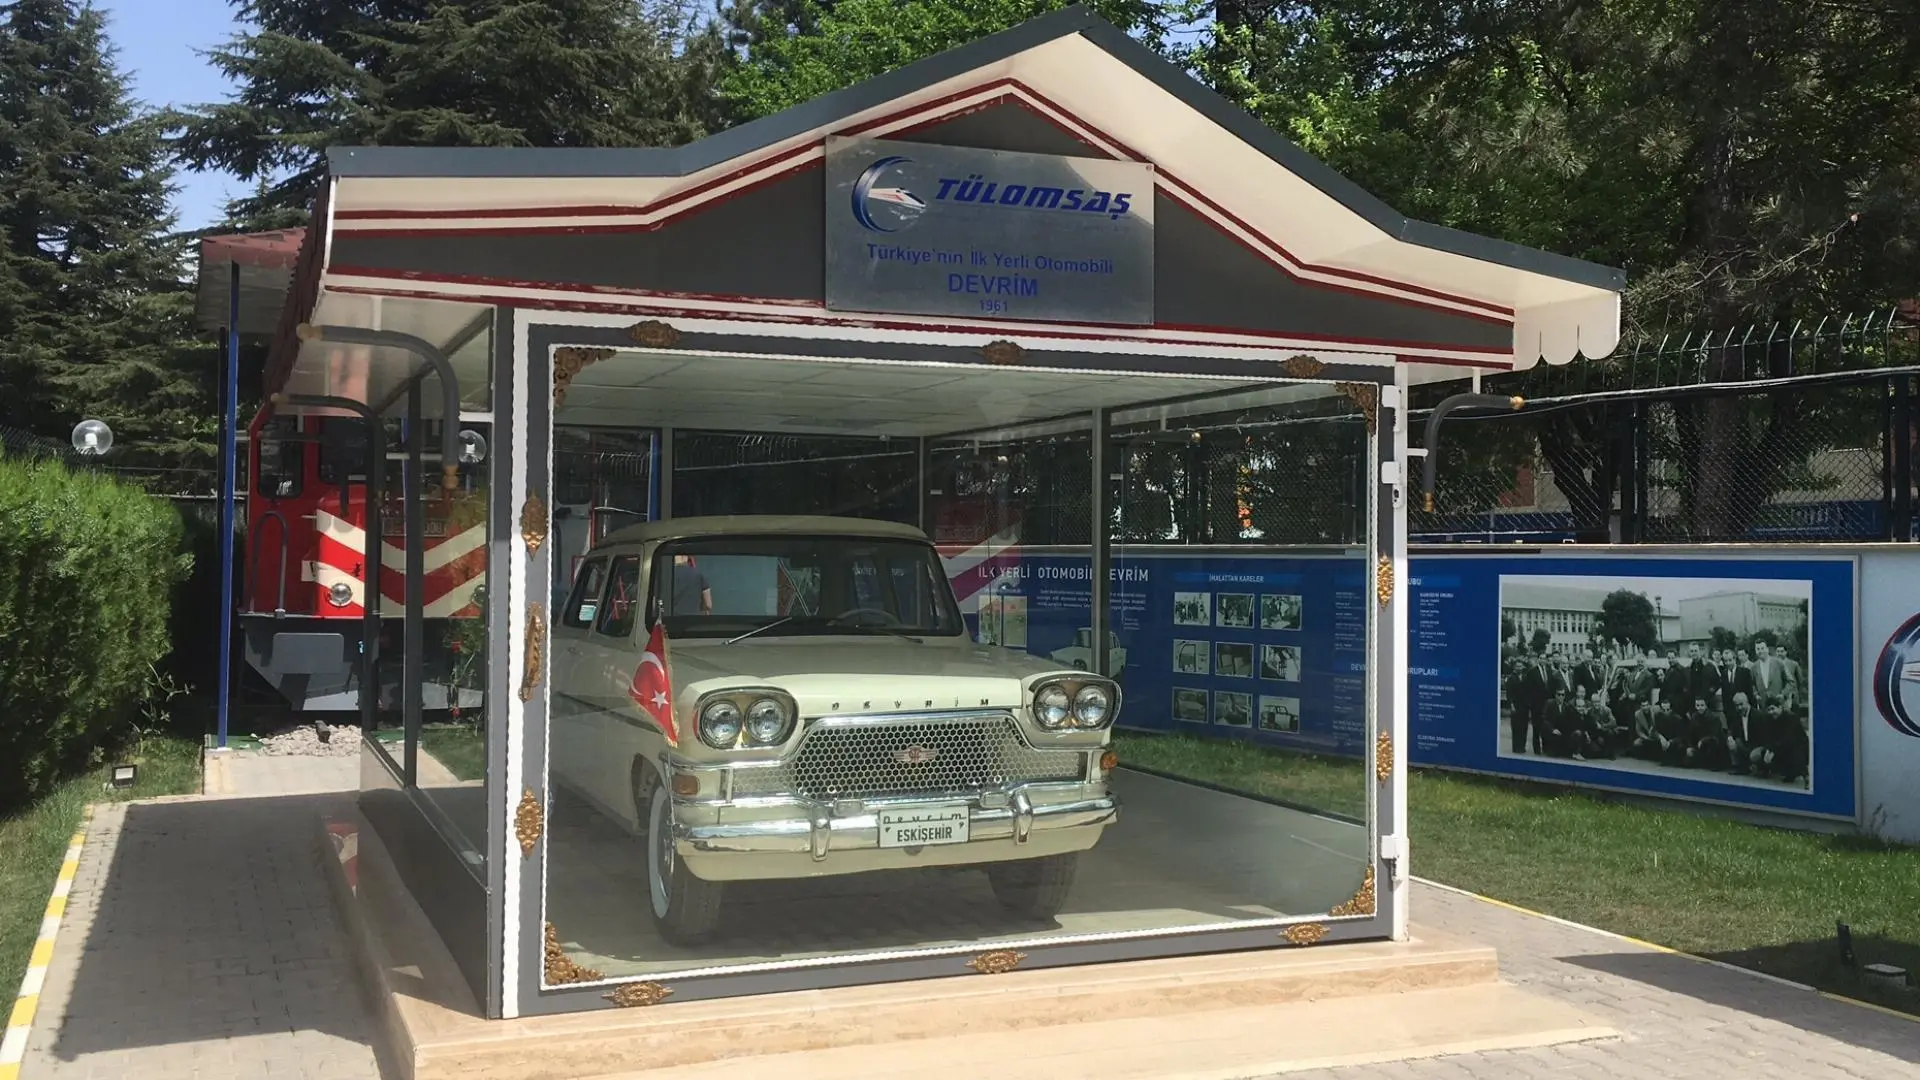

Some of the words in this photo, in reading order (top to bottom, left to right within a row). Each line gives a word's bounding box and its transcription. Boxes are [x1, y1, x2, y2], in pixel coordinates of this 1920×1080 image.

[935, 174, 1132, 220] TÜLOMSAŞ
[1035, 255, 1113, 273] Otomobili
[948, 272, 1039, 297] DEVRİM
[980, 300, 1008, 312] 1961
[1000, 563, 1030, 578] YERLİ
[1109, 566, 1149, 582] EVRİM
[1407, 667, 1439, 676] RUPLARI
[897, 824, 953, 842] ESKİŞEHİR
